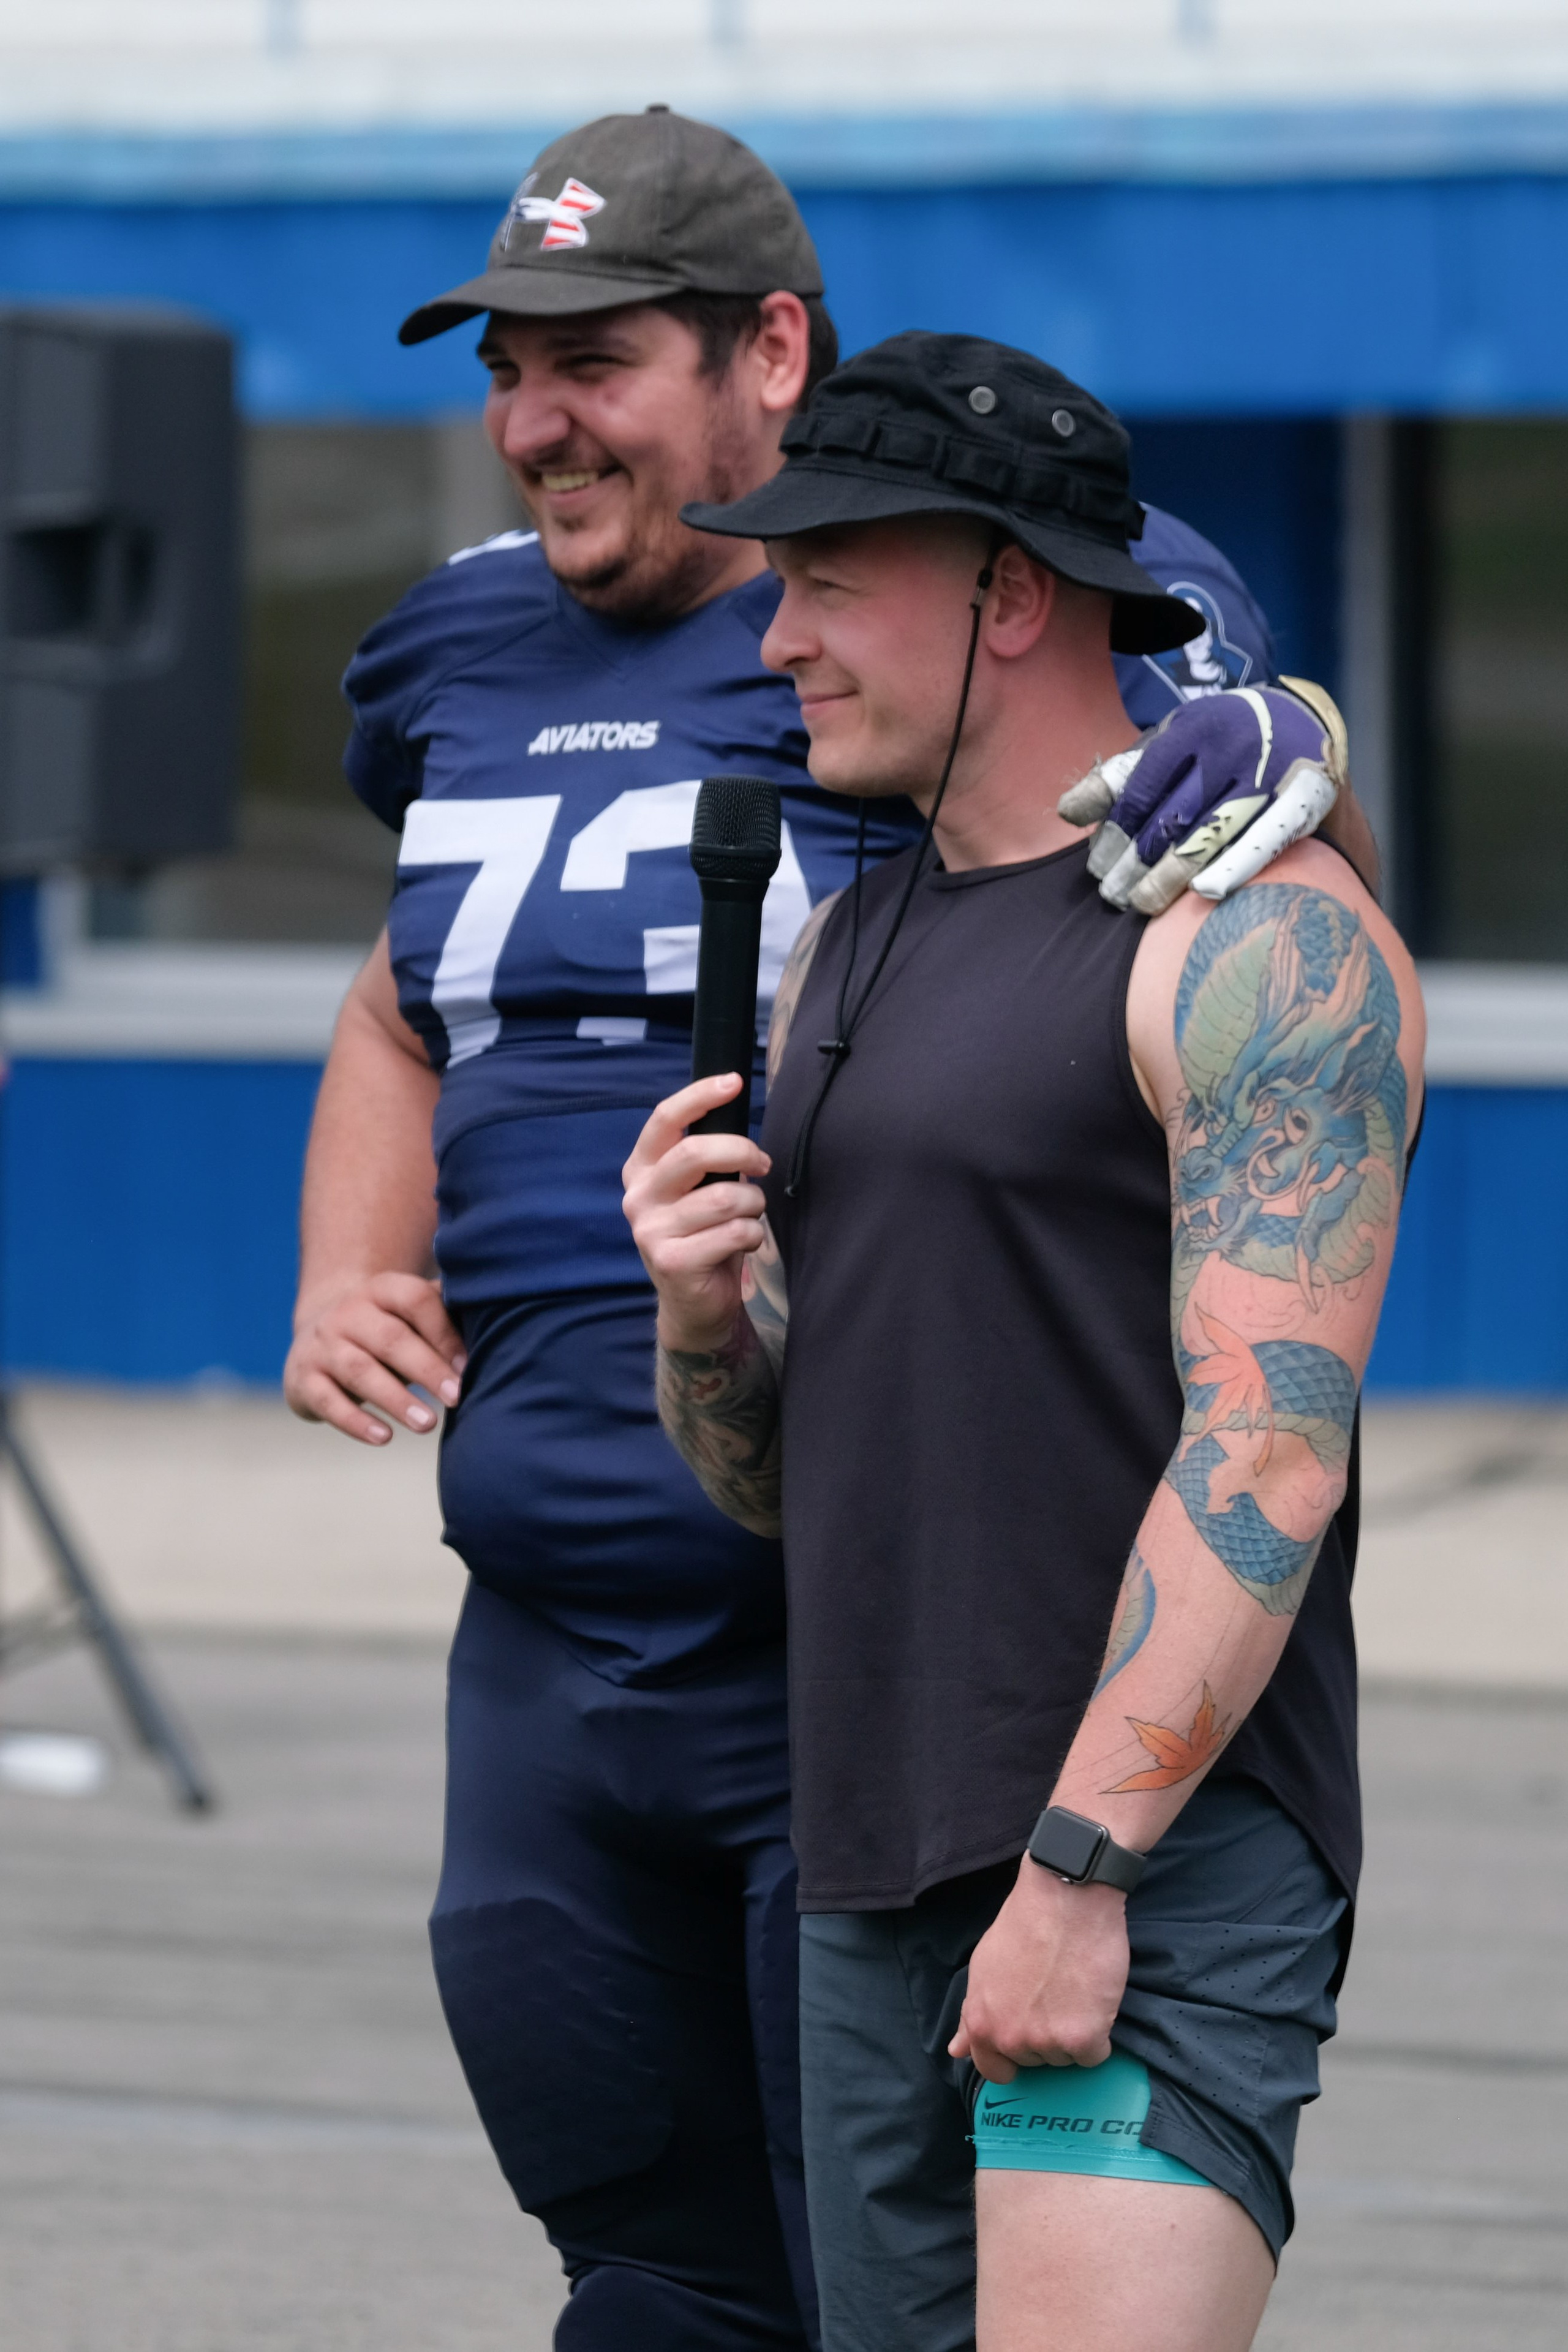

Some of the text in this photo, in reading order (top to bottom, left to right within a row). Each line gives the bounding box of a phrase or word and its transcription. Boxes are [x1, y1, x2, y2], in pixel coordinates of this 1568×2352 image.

[527, 720, 660, 755] AVIATORS
[981, 2112, 1023, 2128] NIKE
[1027, 2115, 1093, 2133] PRO
